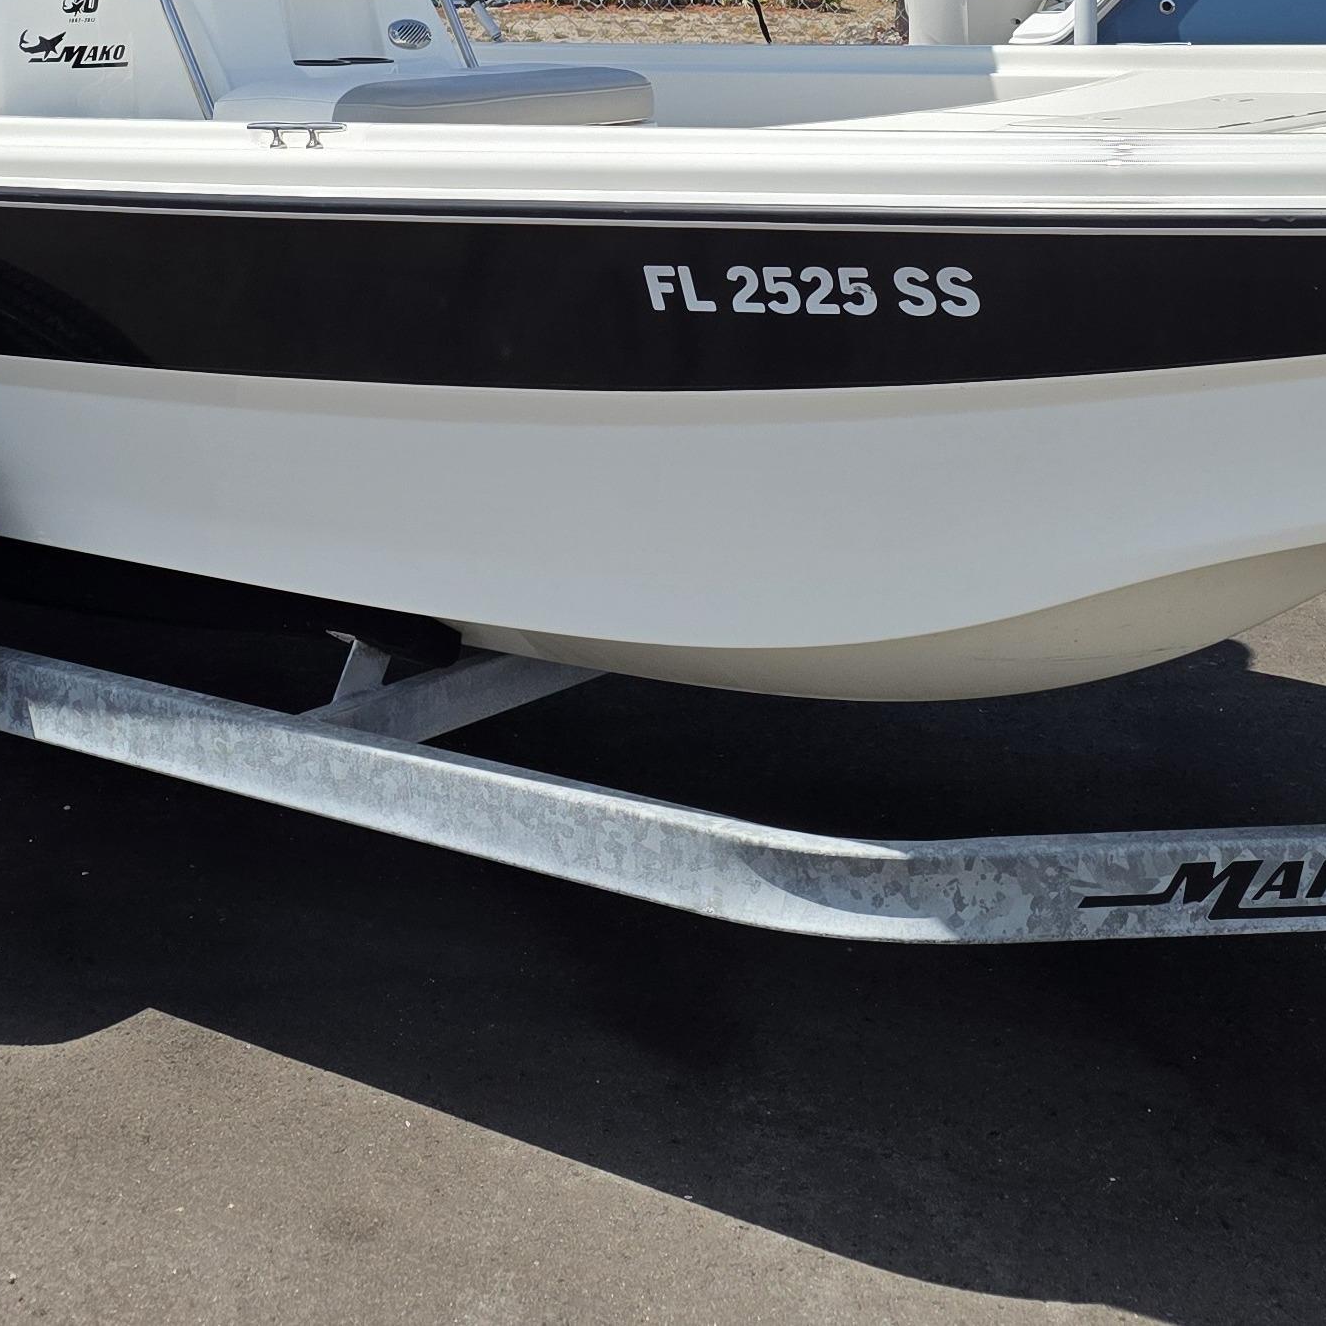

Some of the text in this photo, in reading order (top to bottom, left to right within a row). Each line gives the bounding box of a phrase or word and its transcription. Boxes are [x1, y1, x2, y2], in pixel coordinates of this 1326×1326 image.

[59, 44, 128, 68] MAKO
[643, 265, 980, 317] FL 2525 SS
